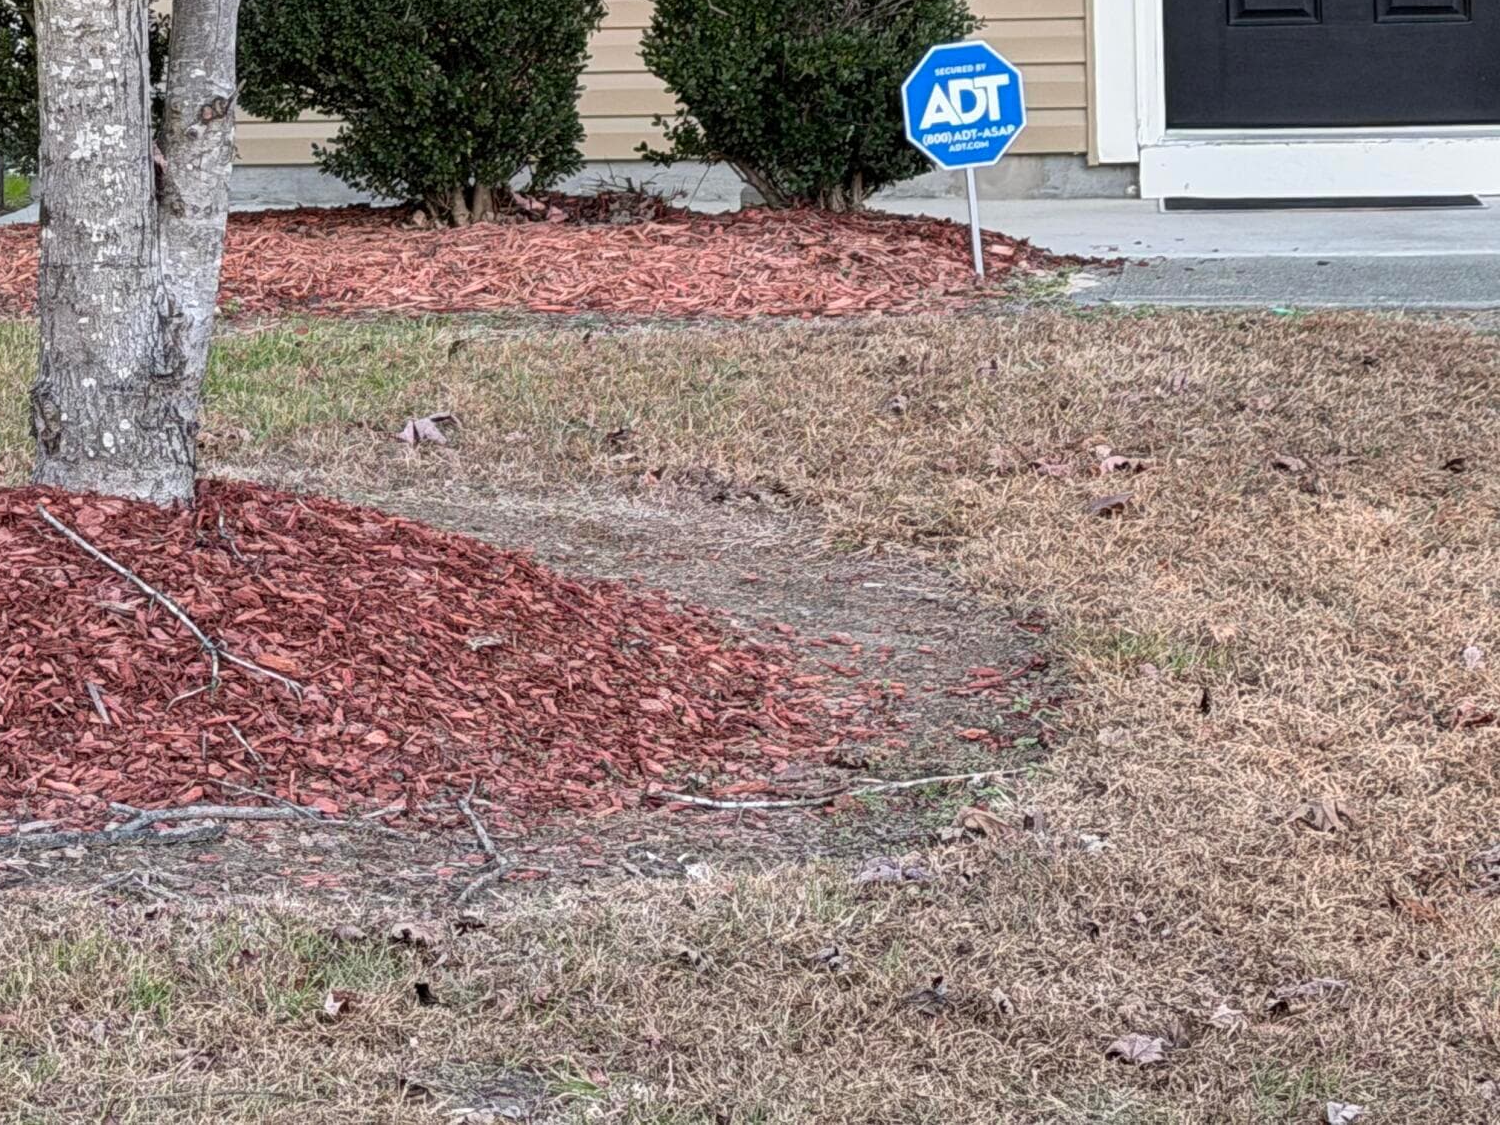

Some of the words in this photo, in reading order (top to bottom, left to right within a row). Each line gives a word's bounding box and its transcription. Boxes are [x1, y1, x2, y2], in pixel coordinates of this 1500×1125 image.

[934, 65, 974, 76] SECURED
[975, 63, 987, 73] BY
[919, 73, 1010, 130] ADT
[922, 132, 953, 146] (800)
[953, 125, 1015, 141] ADT-ASAP
[948, 140, 990, 152] ADT.COM
